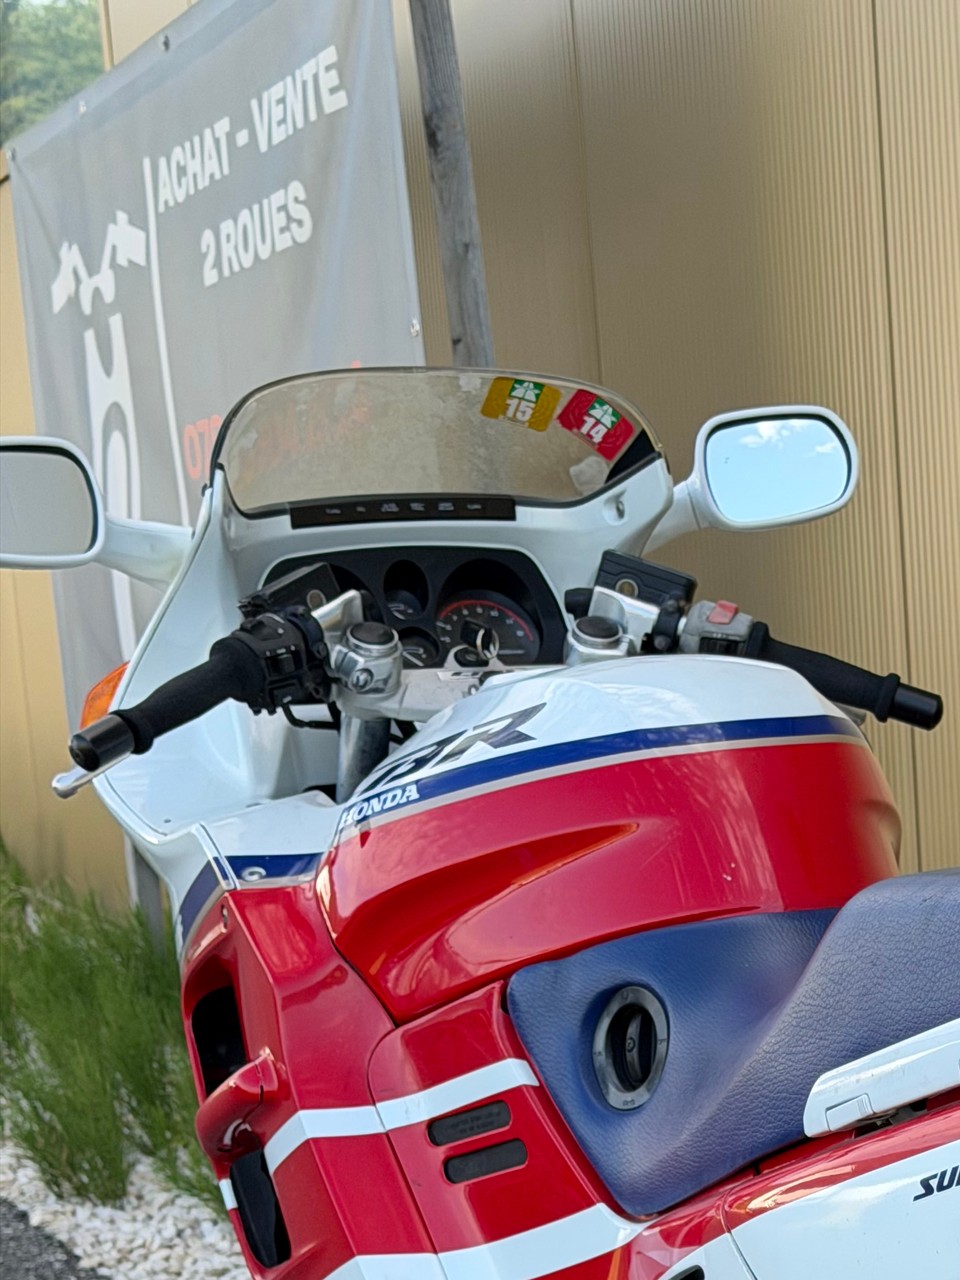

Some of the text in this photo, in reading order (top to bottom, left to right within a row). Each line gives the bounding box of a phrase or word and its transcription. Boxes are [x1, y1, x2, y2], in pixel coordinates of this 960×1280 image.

[158, 115, 231, 213] ACHAT
[251, 44, 348, 153] VENTE
[200, 179, 313, 288] 2 ROUES
[506, 398, 535, 423] 15
[580, 414, 609, 444] 14
[339, 781, 420, 831] HONDA
